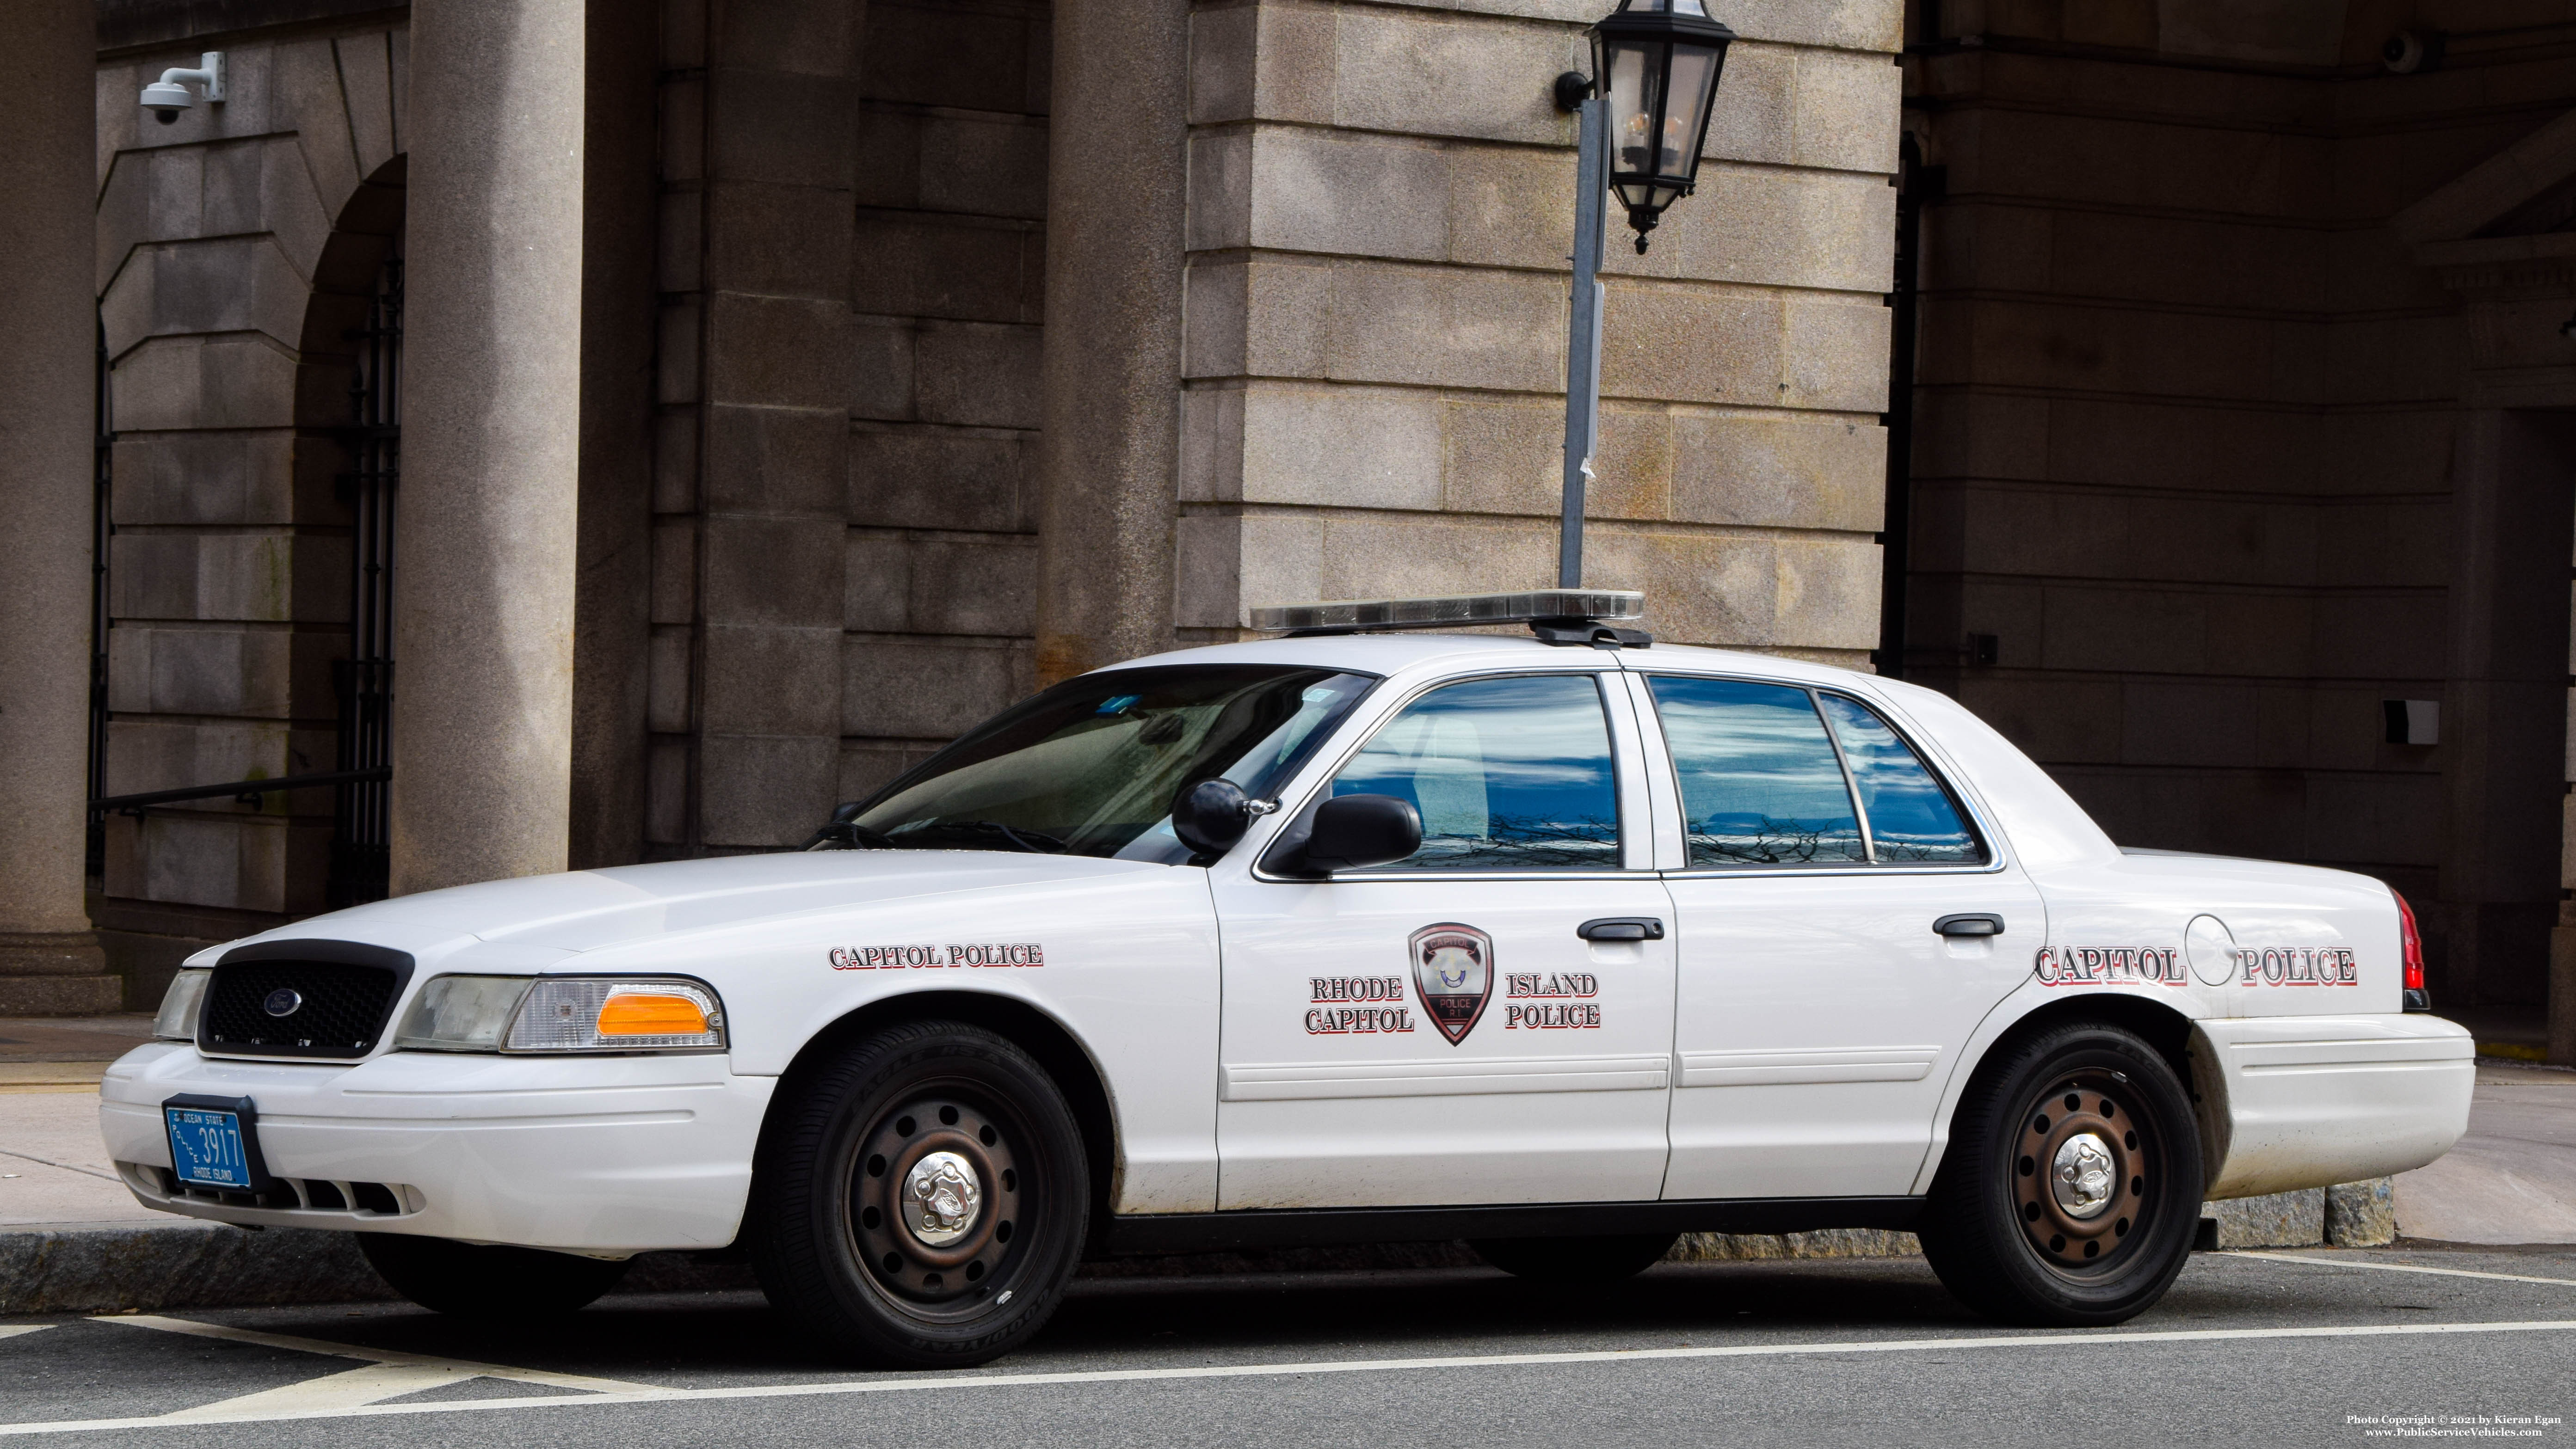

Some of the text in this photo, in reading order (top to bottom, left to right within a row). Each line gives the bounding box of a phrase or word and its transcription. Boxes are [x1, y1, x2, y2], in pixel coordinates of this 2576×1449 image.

[1430, 937, 1469, 948] CAPITOL
[827, 943, 1043, 970] CAPITOL POLICE
[2033, 946, 2358, 987] CAPITOL POLICE
[1309, 976, 1403, 1002] RHODE
[1505, 972, 1598, 998] ISLAND
[1440, 999, 1471, 1008] POLICE
[1449, 1009, 1463, 1017] R.I.
[1505, 1003, 1600, 1029] POLICE
[1304, 1007, 1414, 1034] CAPITOL
[184, 1113, 224, 1126] OCEAN STATE
[172, 1124, 199, 1163] POLICE
[199, 1127, 239, 1167] 3917
[193, 1166, 233, 1181] RHODE ISLAND
